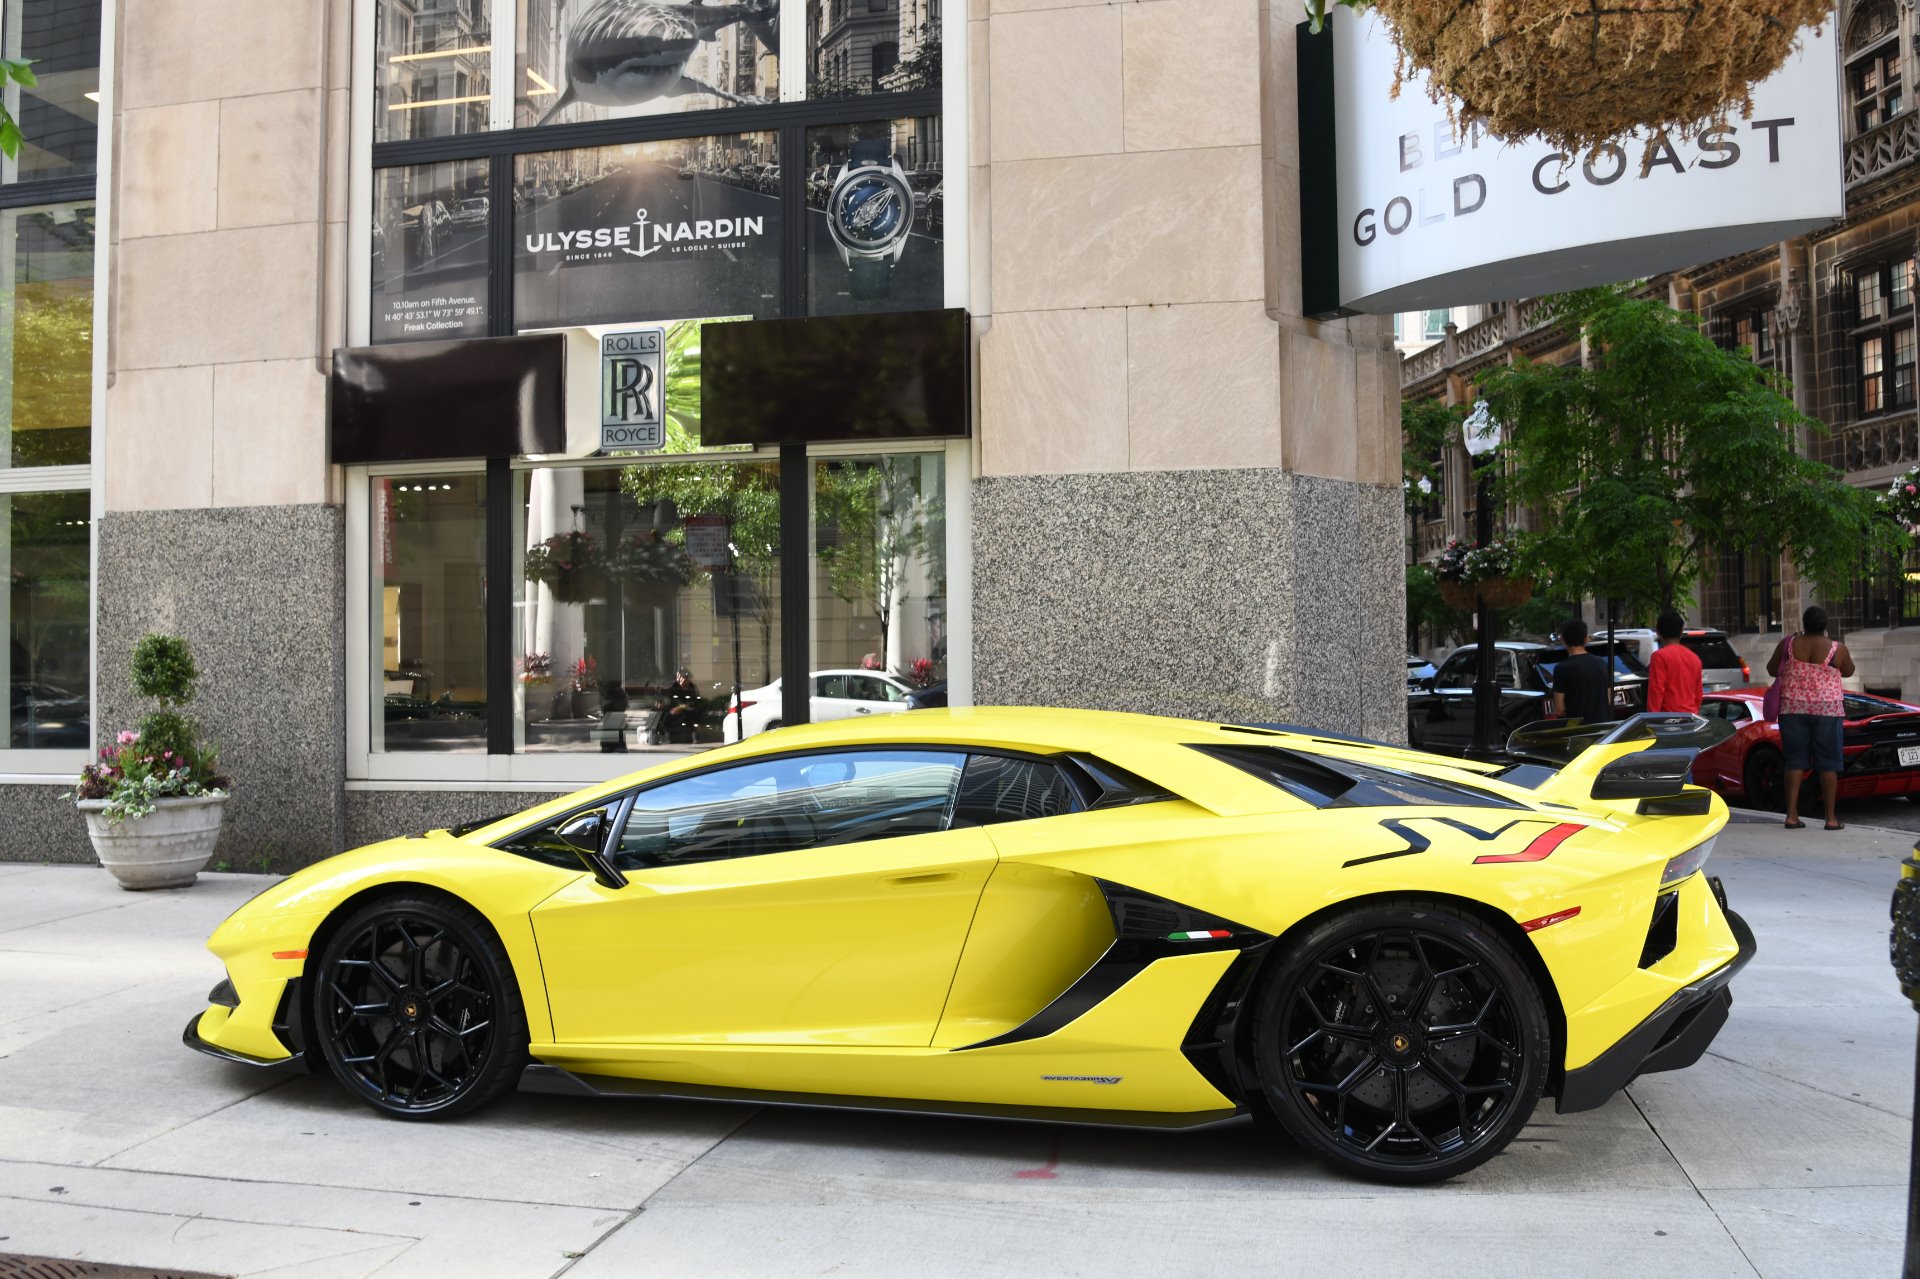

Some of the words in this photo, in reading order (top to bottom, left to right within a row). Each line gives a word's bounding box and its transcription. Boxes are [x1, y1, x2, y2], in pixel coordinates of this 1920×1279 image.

[1353, 173, 1487, 247] GOLD
[1532, 117, 1795, 195] COAST
[526, 226, 631, 253] ULYSSE
[653, 215, 764, 243] NARDIN
[683, 244, 708, 252] LOCLE
[717, 241, 746, 249] SUISSE
[566, 253, 590, 261] SINCE
[431, 297, 448, 306] Fifth
[384, 313, 391, 322] N
[433, 310, 441, 318] W
[404, 323, 425, 332] Freak
[426, 320, 463, 330] Collection
[606, 335, 656, 351] ROLLS
[606, 427, 656, 443] ROYCE
